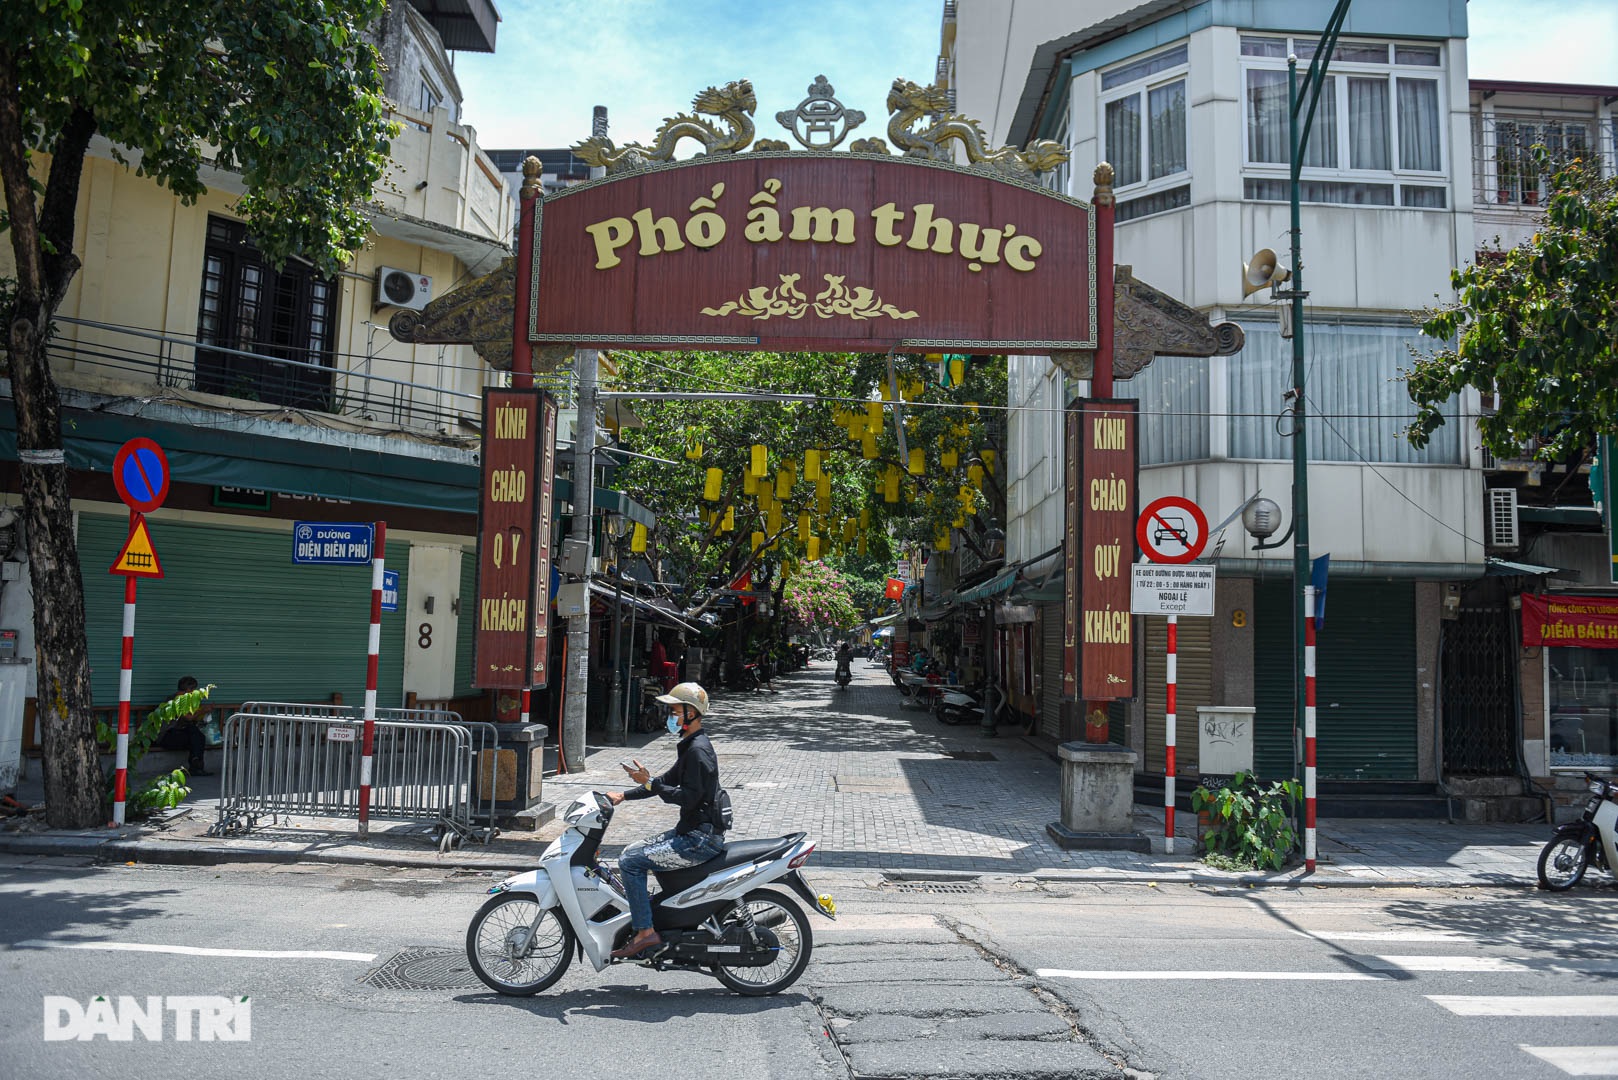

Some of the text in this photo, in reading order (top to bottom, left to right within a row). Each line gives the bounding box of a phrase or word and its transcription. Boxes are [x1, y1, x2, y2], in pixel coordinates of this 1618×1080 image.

[585, 178, 1043, 272] Phố ẩm thực
[495, 401, 528, 440] KÍNH
[1093, 413, 1126, 450] KÍNH
[491, 464, 526, 503] CHÀO
[1090, 473, 1127, 512] CHÀO
[298, 539, 368, 560] ĐIỆN BIÊN PHỦ
[1094, 539, 1121, 581] QUÝ
[1135, 569, 1142, 577] XE
[481, 592, 526, 632] KHÁCH
[1158, 592, 1179, 602] NGOẠI
[1160, 602, 1186, 611] Except
[1568, 604, 1587, 614] CÔNG
[1085, 604, 1130, 644] KHÁCH
[1232, 609, 1247, 628] 8
[1541, 619, 1575, 638] ĐIỂM
[1578, 621, 1606, 639] BÁN
[418, 623, 433, 649] 8
